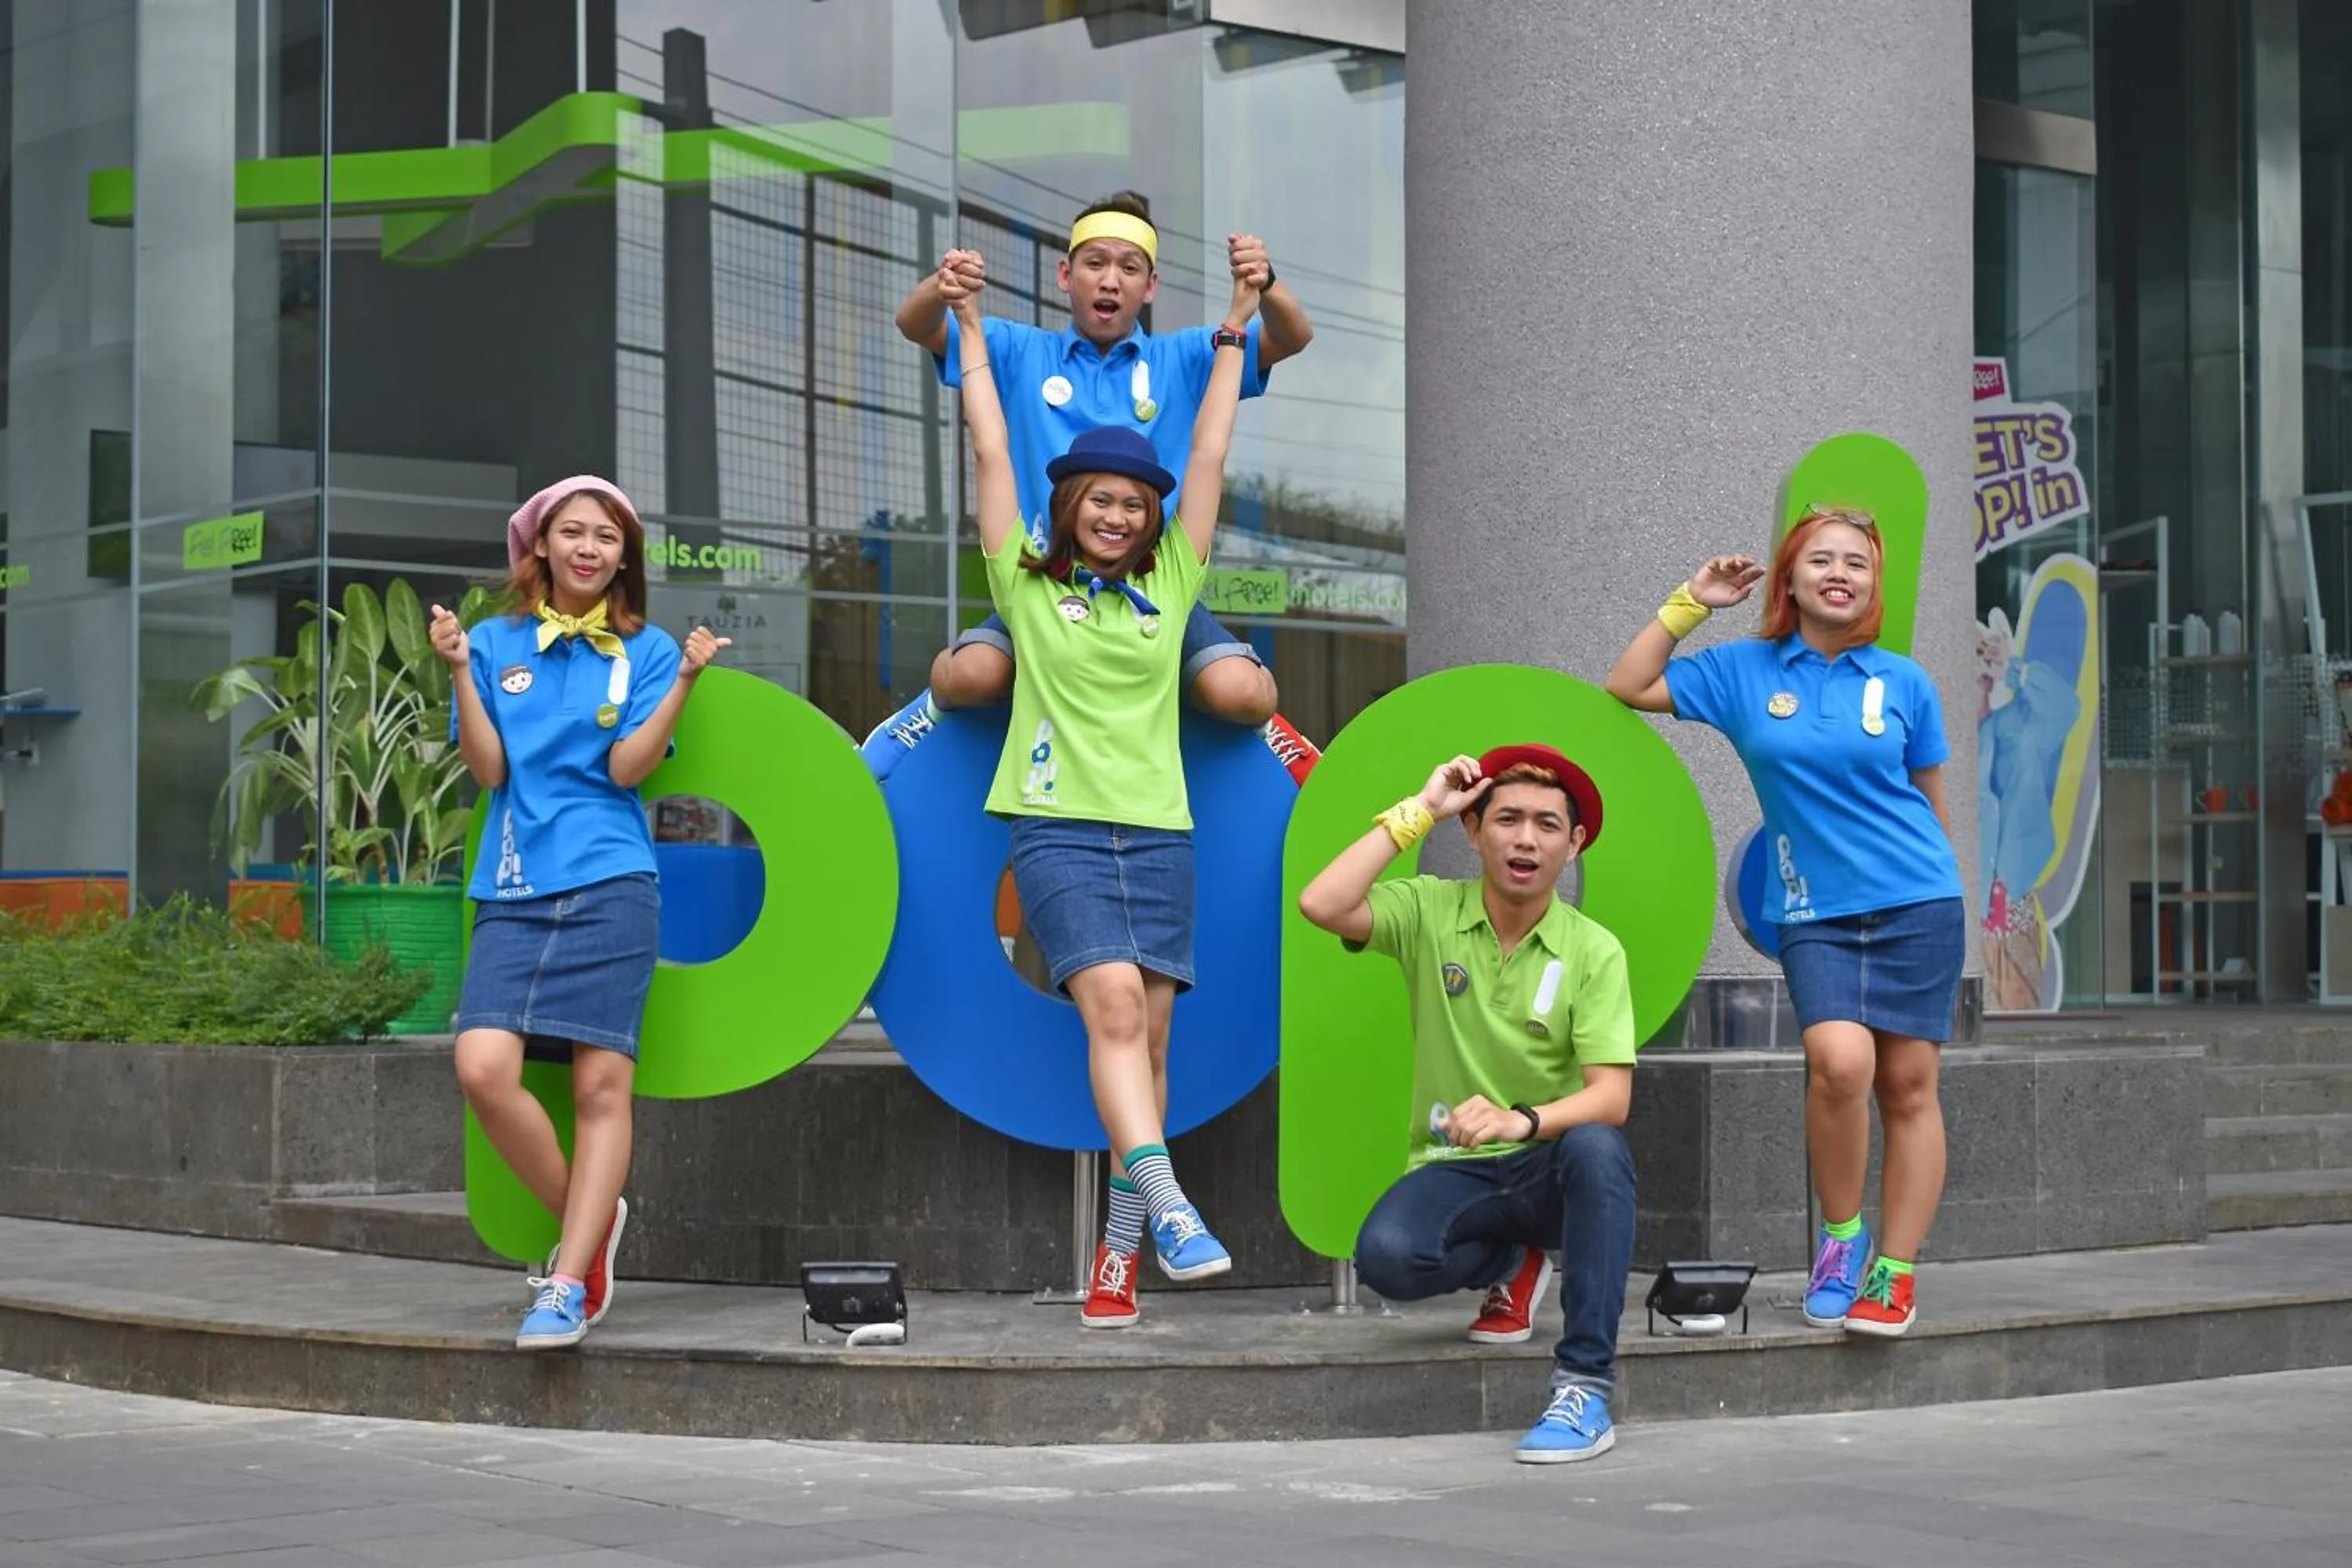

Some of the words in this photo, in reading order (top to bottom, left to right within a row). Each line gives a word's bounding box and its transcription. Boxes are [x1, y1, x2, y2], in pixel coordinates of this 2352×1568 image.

[1973, 413, 2069, 479] ET'S
[2031, 466, 2081, 519] in
[646, 535, 762, 572] els.com
[687, 615, 767, 628] TAUZIA
[496, 884, 535, 898] HOTELS
[1784, 908, 1816, 923] HOTELS
